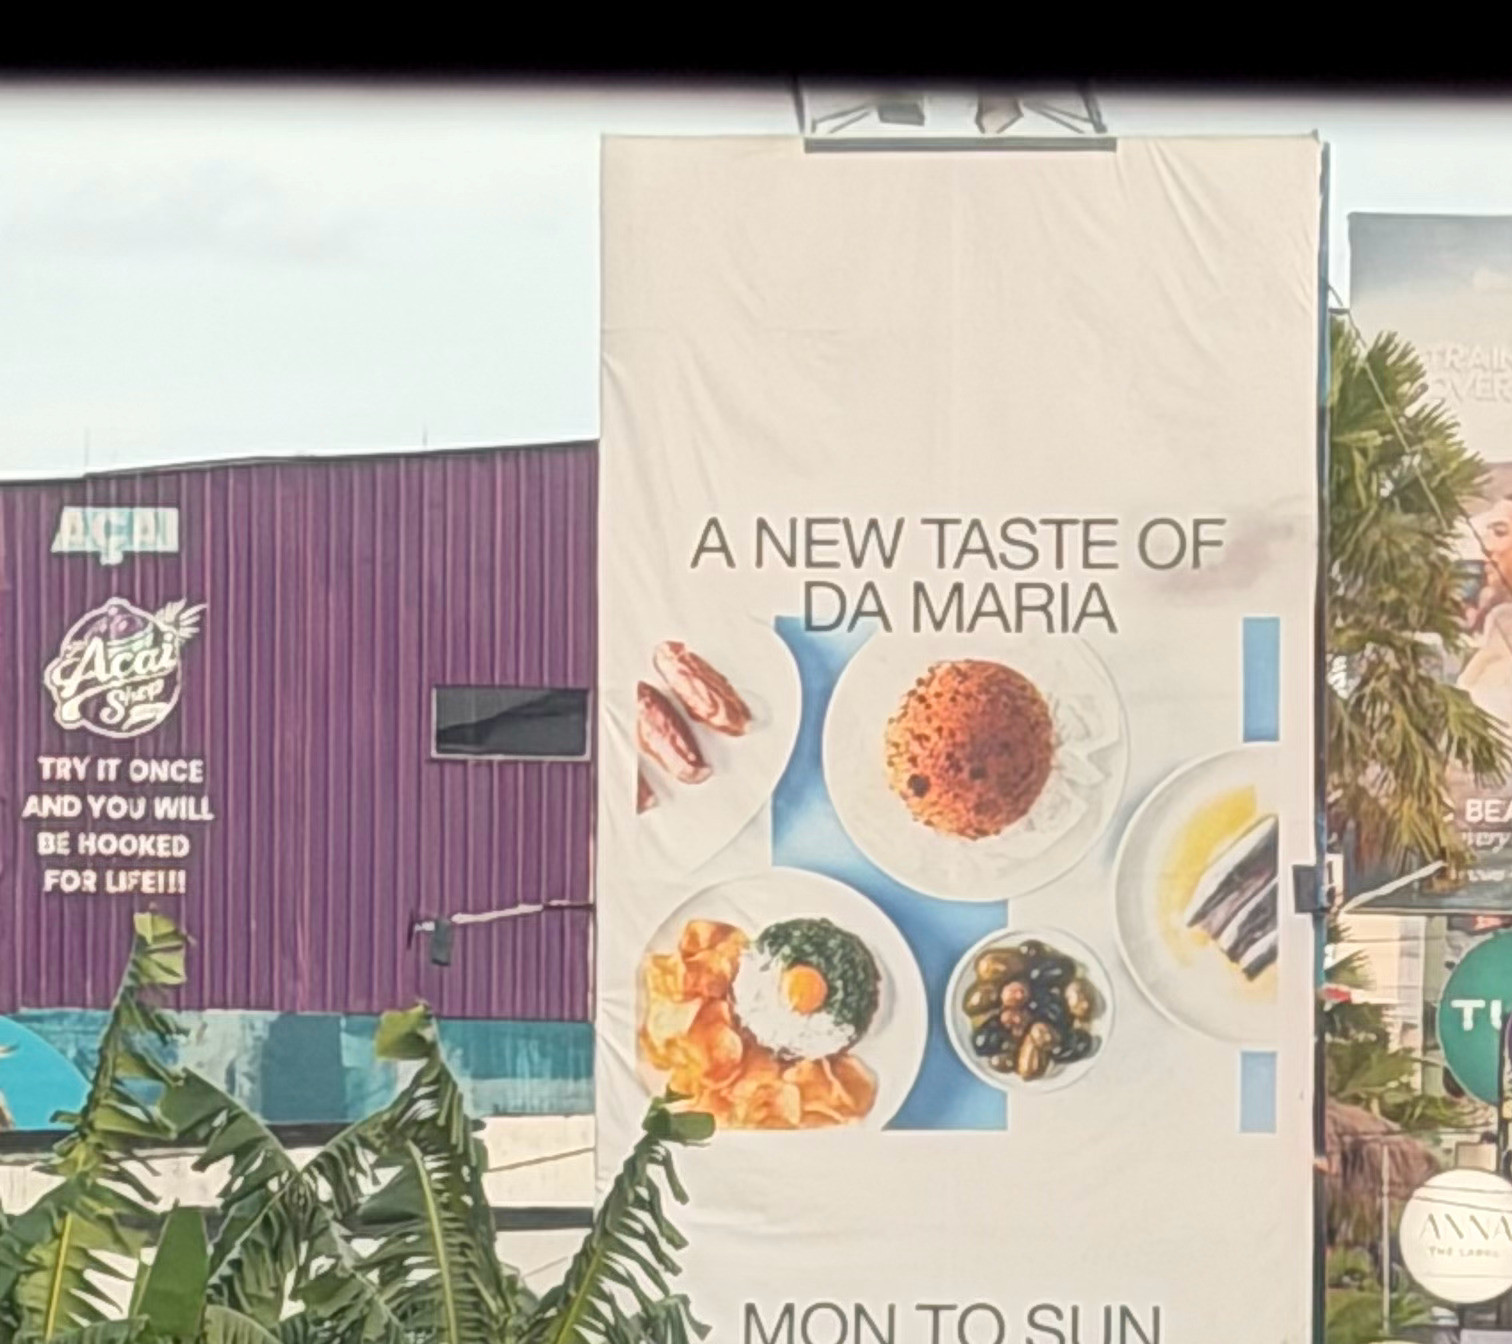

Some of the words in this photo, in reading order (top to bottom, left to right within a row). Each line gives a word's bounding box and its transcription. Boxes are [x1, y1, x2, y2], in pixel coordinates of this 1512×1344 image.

[690, 516, 737, 570] A
[754, 516, 905, 570] NEW
[920, 516, 1120, 571] TASTE
[1137, 516, 1228, 571] OF
[804, 580, 894, 633] DA
[912, 581, 1118, 634] MARIA
[38, 755, 92, 782] TRY
[97, 757, 123, 782] IT
[129, 758, 205, 784] ONCE
[21, 794, 83, 819] AND
[87, 795, 147, 820] YOU
[153, 796, 215, 821] WILL
[36, 831, 72, 856] BE
[76, 832, 191, 859] HOOKED
[43, 868, 98, 894] FOR
